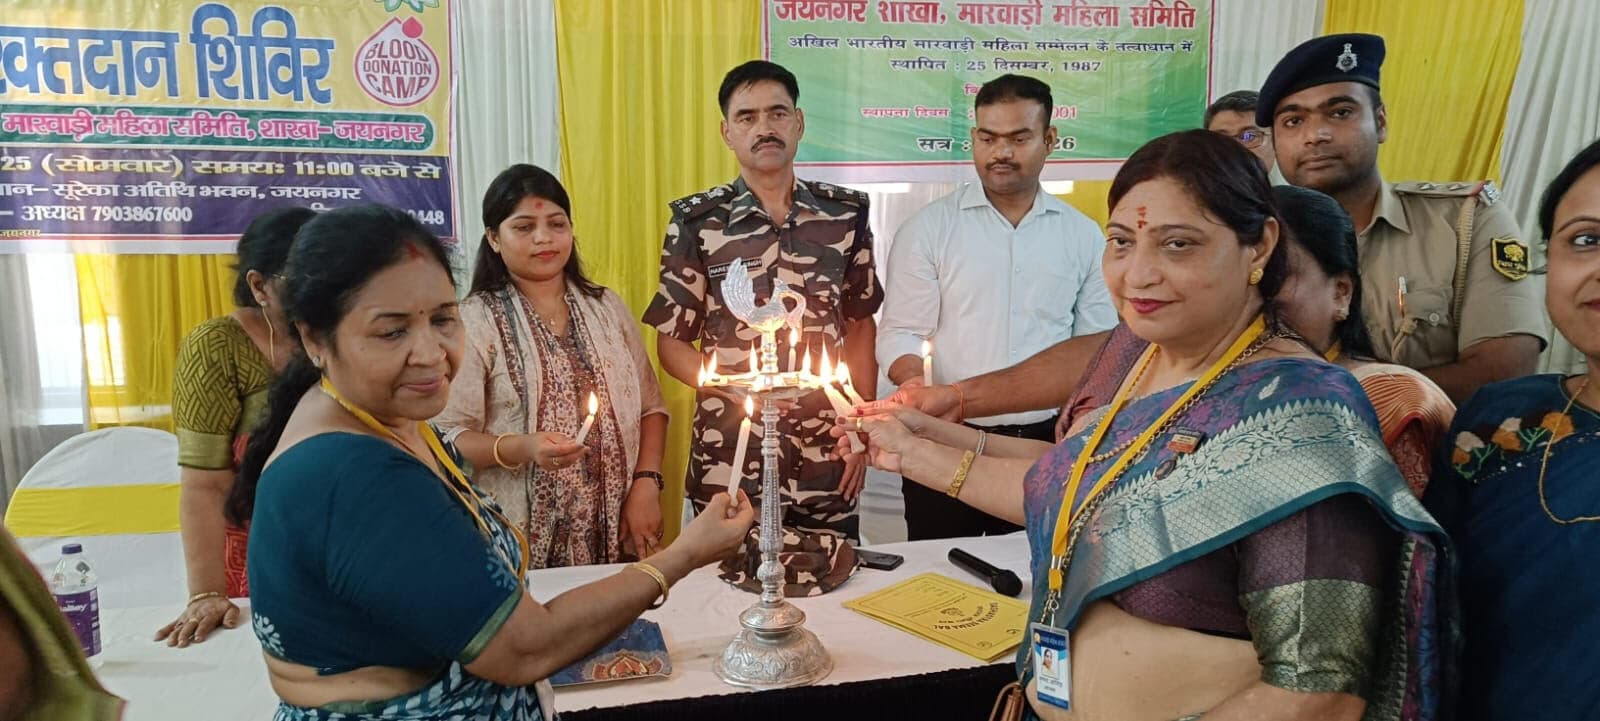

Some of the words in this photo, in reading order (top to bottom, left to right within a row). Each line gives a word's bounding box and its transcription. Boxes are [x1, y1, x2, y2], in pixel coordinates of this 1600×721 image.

[775, 0, 867, 22] जयनगर
[878, 0, 947, 25] शाखा,
[957, 0, 1042, 30] मारवाड़ी
[1053, 0, 1120, 27] महिला
[1130, 1, 1196, 28] समिति
[190, 4, 334, 103] शिविर
[364, 39, 428, 61] BLOOD
[789, 34, 839, 48] अखिल
[847, 35, 907, 49] भारतीय
[914, 37, 975, 53] मारवाड़ी
[982, 37, 1028, 51] महिला
[1036, 39, 1089, 51] सम्मेलन
[1097, 39, 1109, 51] के
[1181, 40, 1193, 52] में
[363, 60, 432, 75] DONATION
[890, 57, 947, 71] स्थापित
[967, 60, 986, 71] 25
[994, 58, 1054, 73] दिसम्बर,
[1063, 62, 1101, 71] 1987
[366, 74, 429, 99] CAMP
[916, 106, 949, 117] दिवस
[3, 109, 93, 140] मारवाड़ी
[98, 111, 168, 136] महिला
[173, 113, 256, 140] समिति,
[334, 122, 424, 142] जयनगर
[919, 138, 952, 150] सत्र
[41, 154, 184, 177] (सोमवार)
[294, 161, 354, 176] 11:00
[360, 160, 409, 178] बजे
[413, 163, 442, 179] से
[53, 180, 120, 200] सूरेका
[124, 181, 196, 198] अतिथि
[200, 184, 265, 200] भवन,
[270, 186, 361, 200] जयनगर
[22, 204, 86, 221] अध्यक्ष
[91, 206, 193, 222] 7903867600
